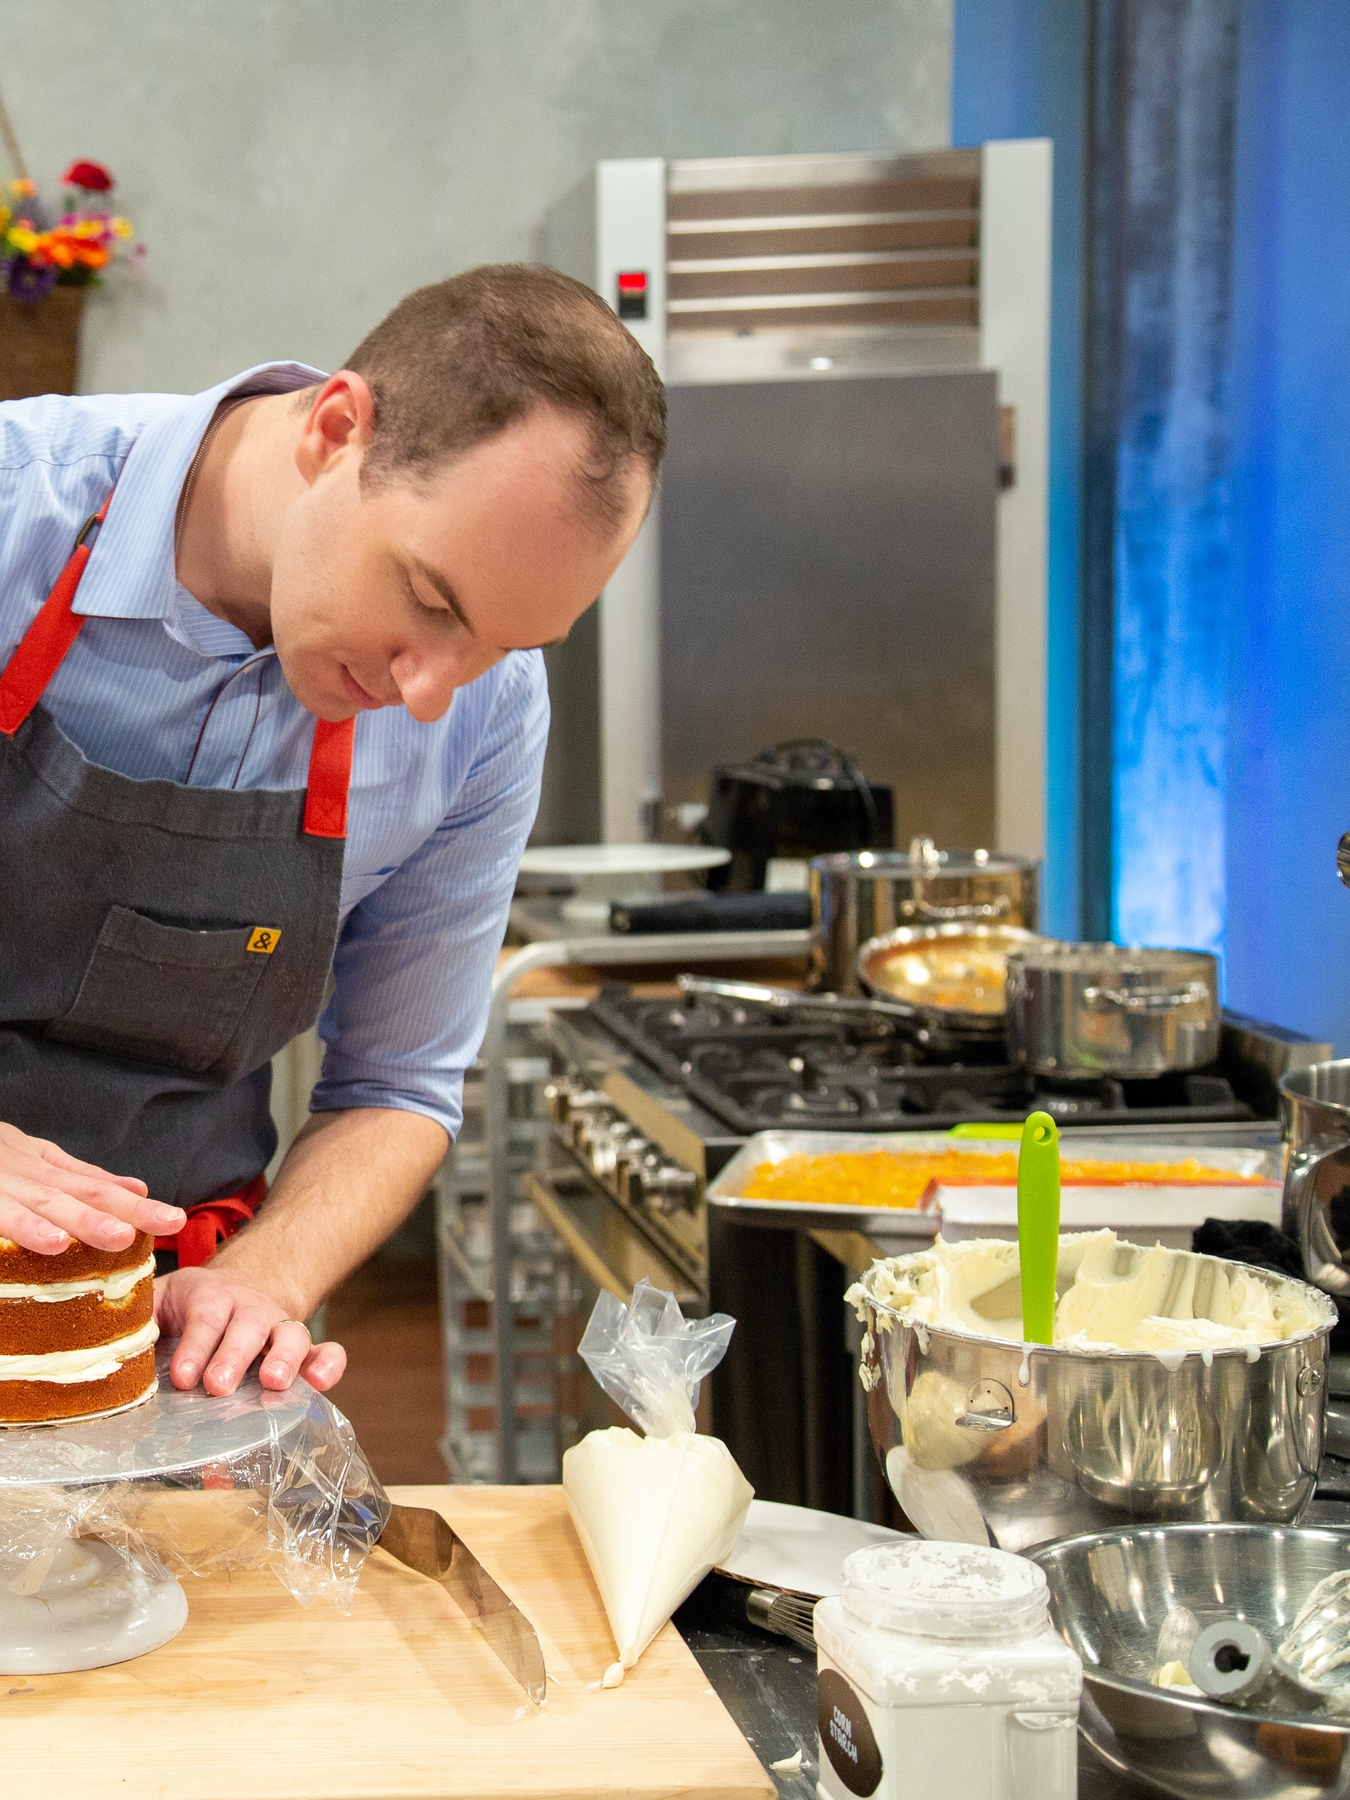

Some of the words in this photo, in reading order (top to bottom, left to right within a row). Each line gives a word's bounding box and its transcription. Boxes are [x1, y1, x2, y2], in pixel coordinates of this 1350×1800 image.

[253, 932, 271, 949] &
[833, 1705, 852, 1739] CORN
[830, 1719, 858, 1764] STARCH
